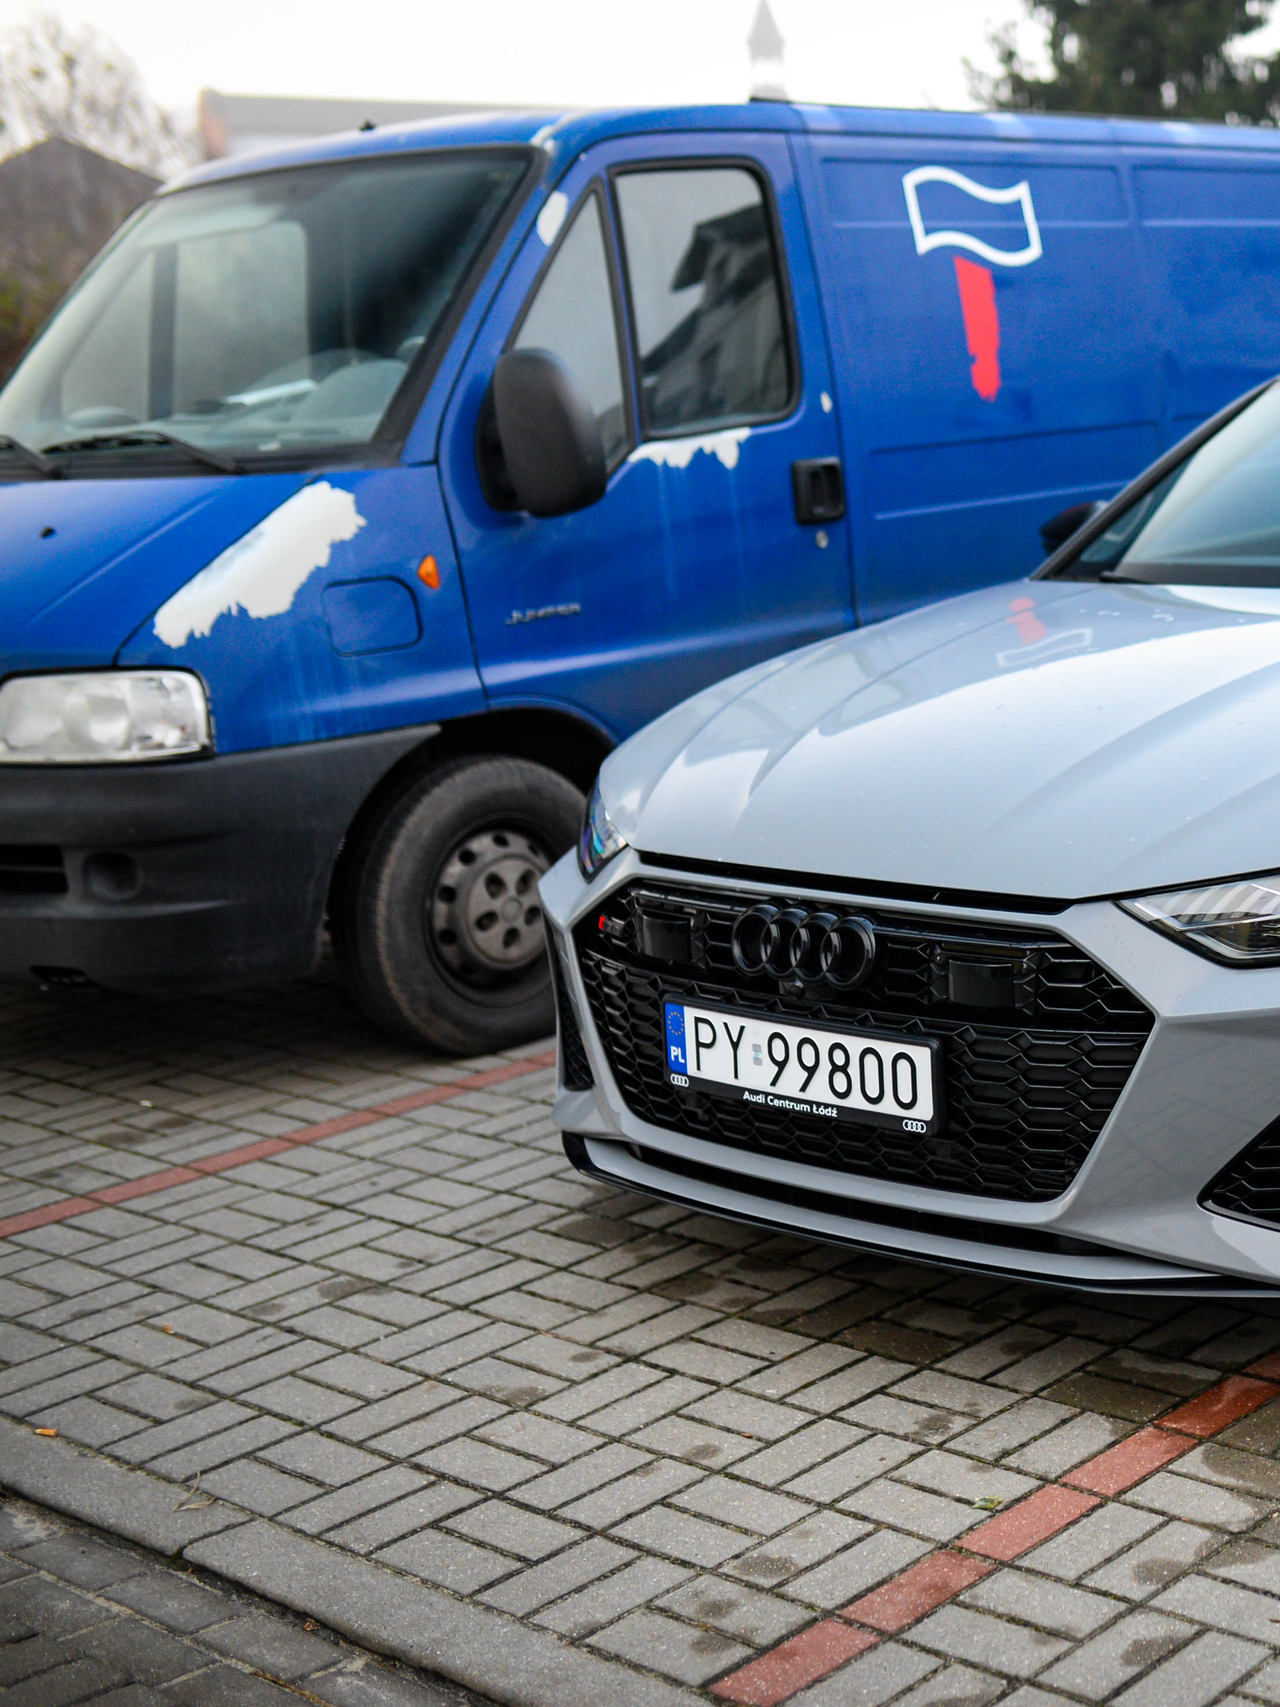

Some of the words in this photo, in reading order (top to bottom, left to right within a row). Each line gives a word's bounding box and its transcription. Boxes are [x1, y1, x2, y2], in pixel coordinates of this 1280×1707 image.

[670, 1045, 685, 1063] PL
[693, 1015, 746, 1080] PY
[766, 1031, 919, 1111] 99800
[743, 1090, 766, 1104] Audi
[767, 1095, 811, 1113] Centrum
[812, 1103, 838, 1118] Łódź
